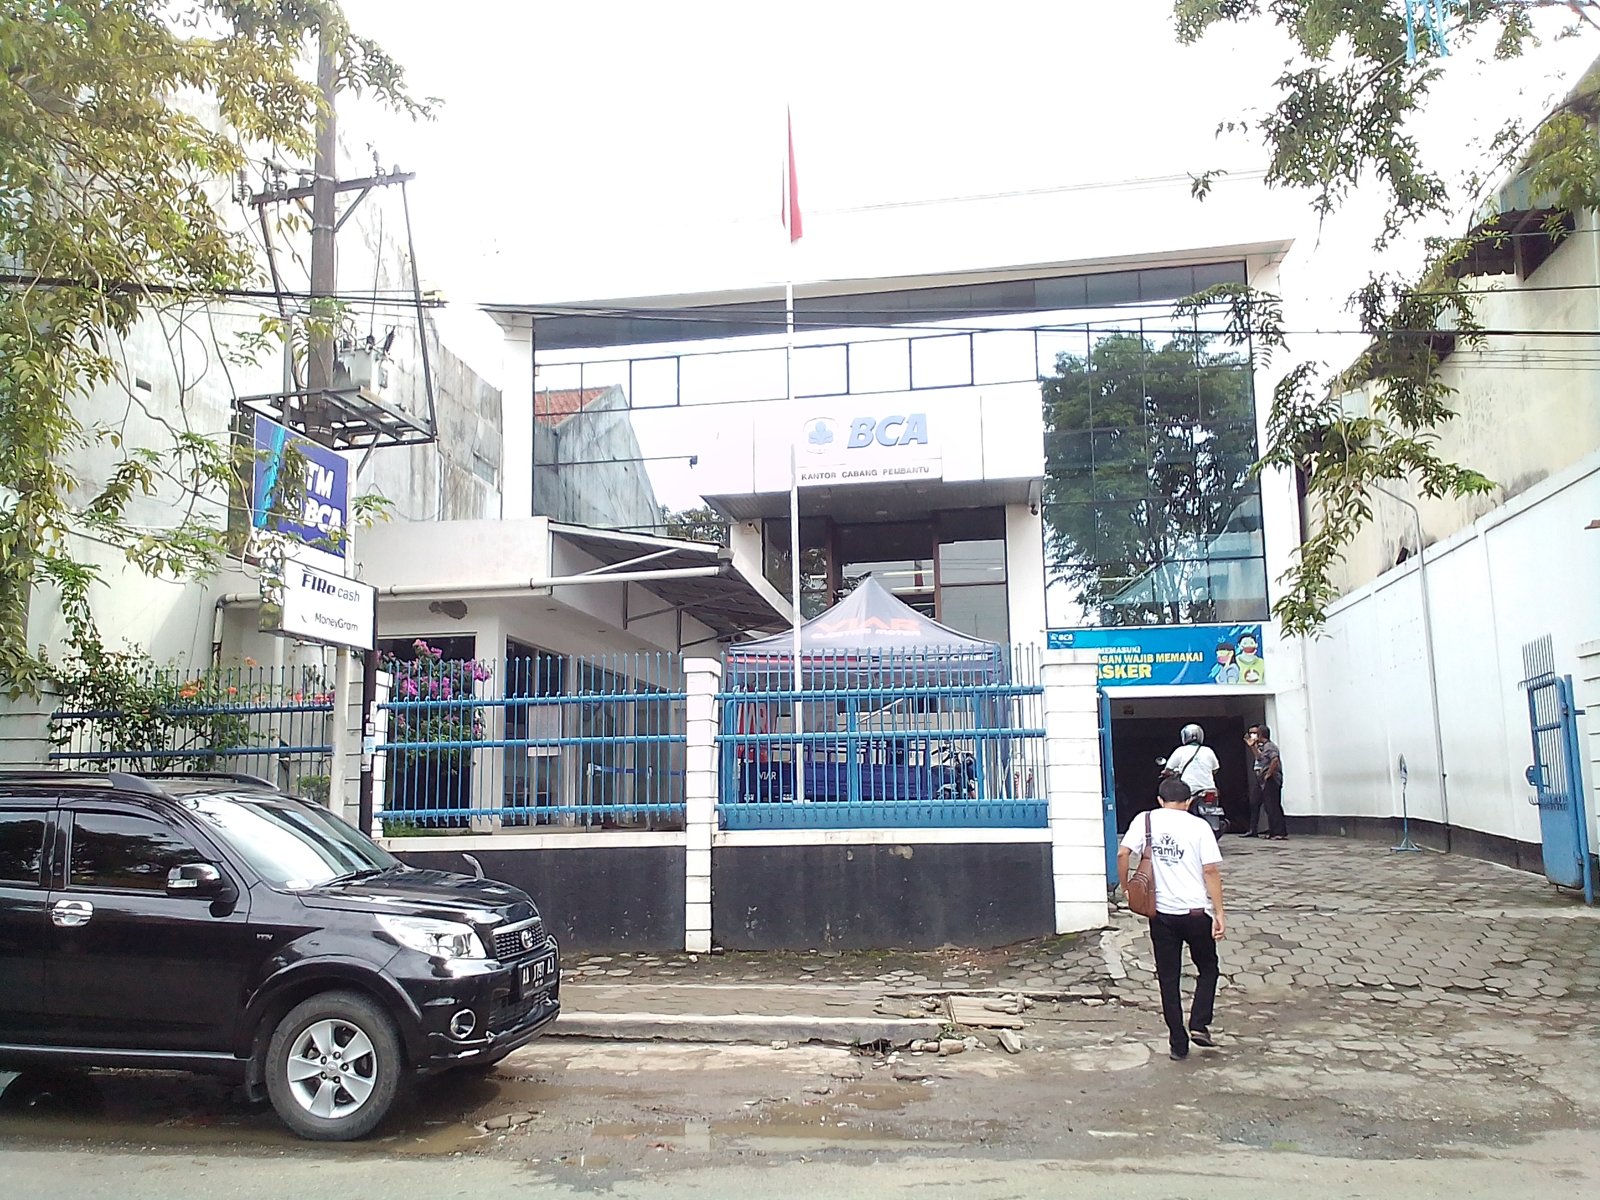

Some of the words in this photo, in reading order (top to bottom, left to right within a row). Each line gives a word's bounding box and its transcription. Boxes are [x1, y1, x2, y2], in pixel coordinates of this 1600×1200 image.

[847, 413, 929, 449] BCA
[801, 472, 837, 480] KANTOR
[842, 469, 878, 478] CABANG
[882, 466, 930, 475] PEMBANTU
[303, 496, 342, 534] BCA
[337, 587, 360, 602] cash
[315, 612, 359, 631] MoneyGram
[1124, 654, 1154, 663] WAJIB
[1156, 652, 1203, 662] MEMAKAI
[1151, 844, 1184, 859] Family
